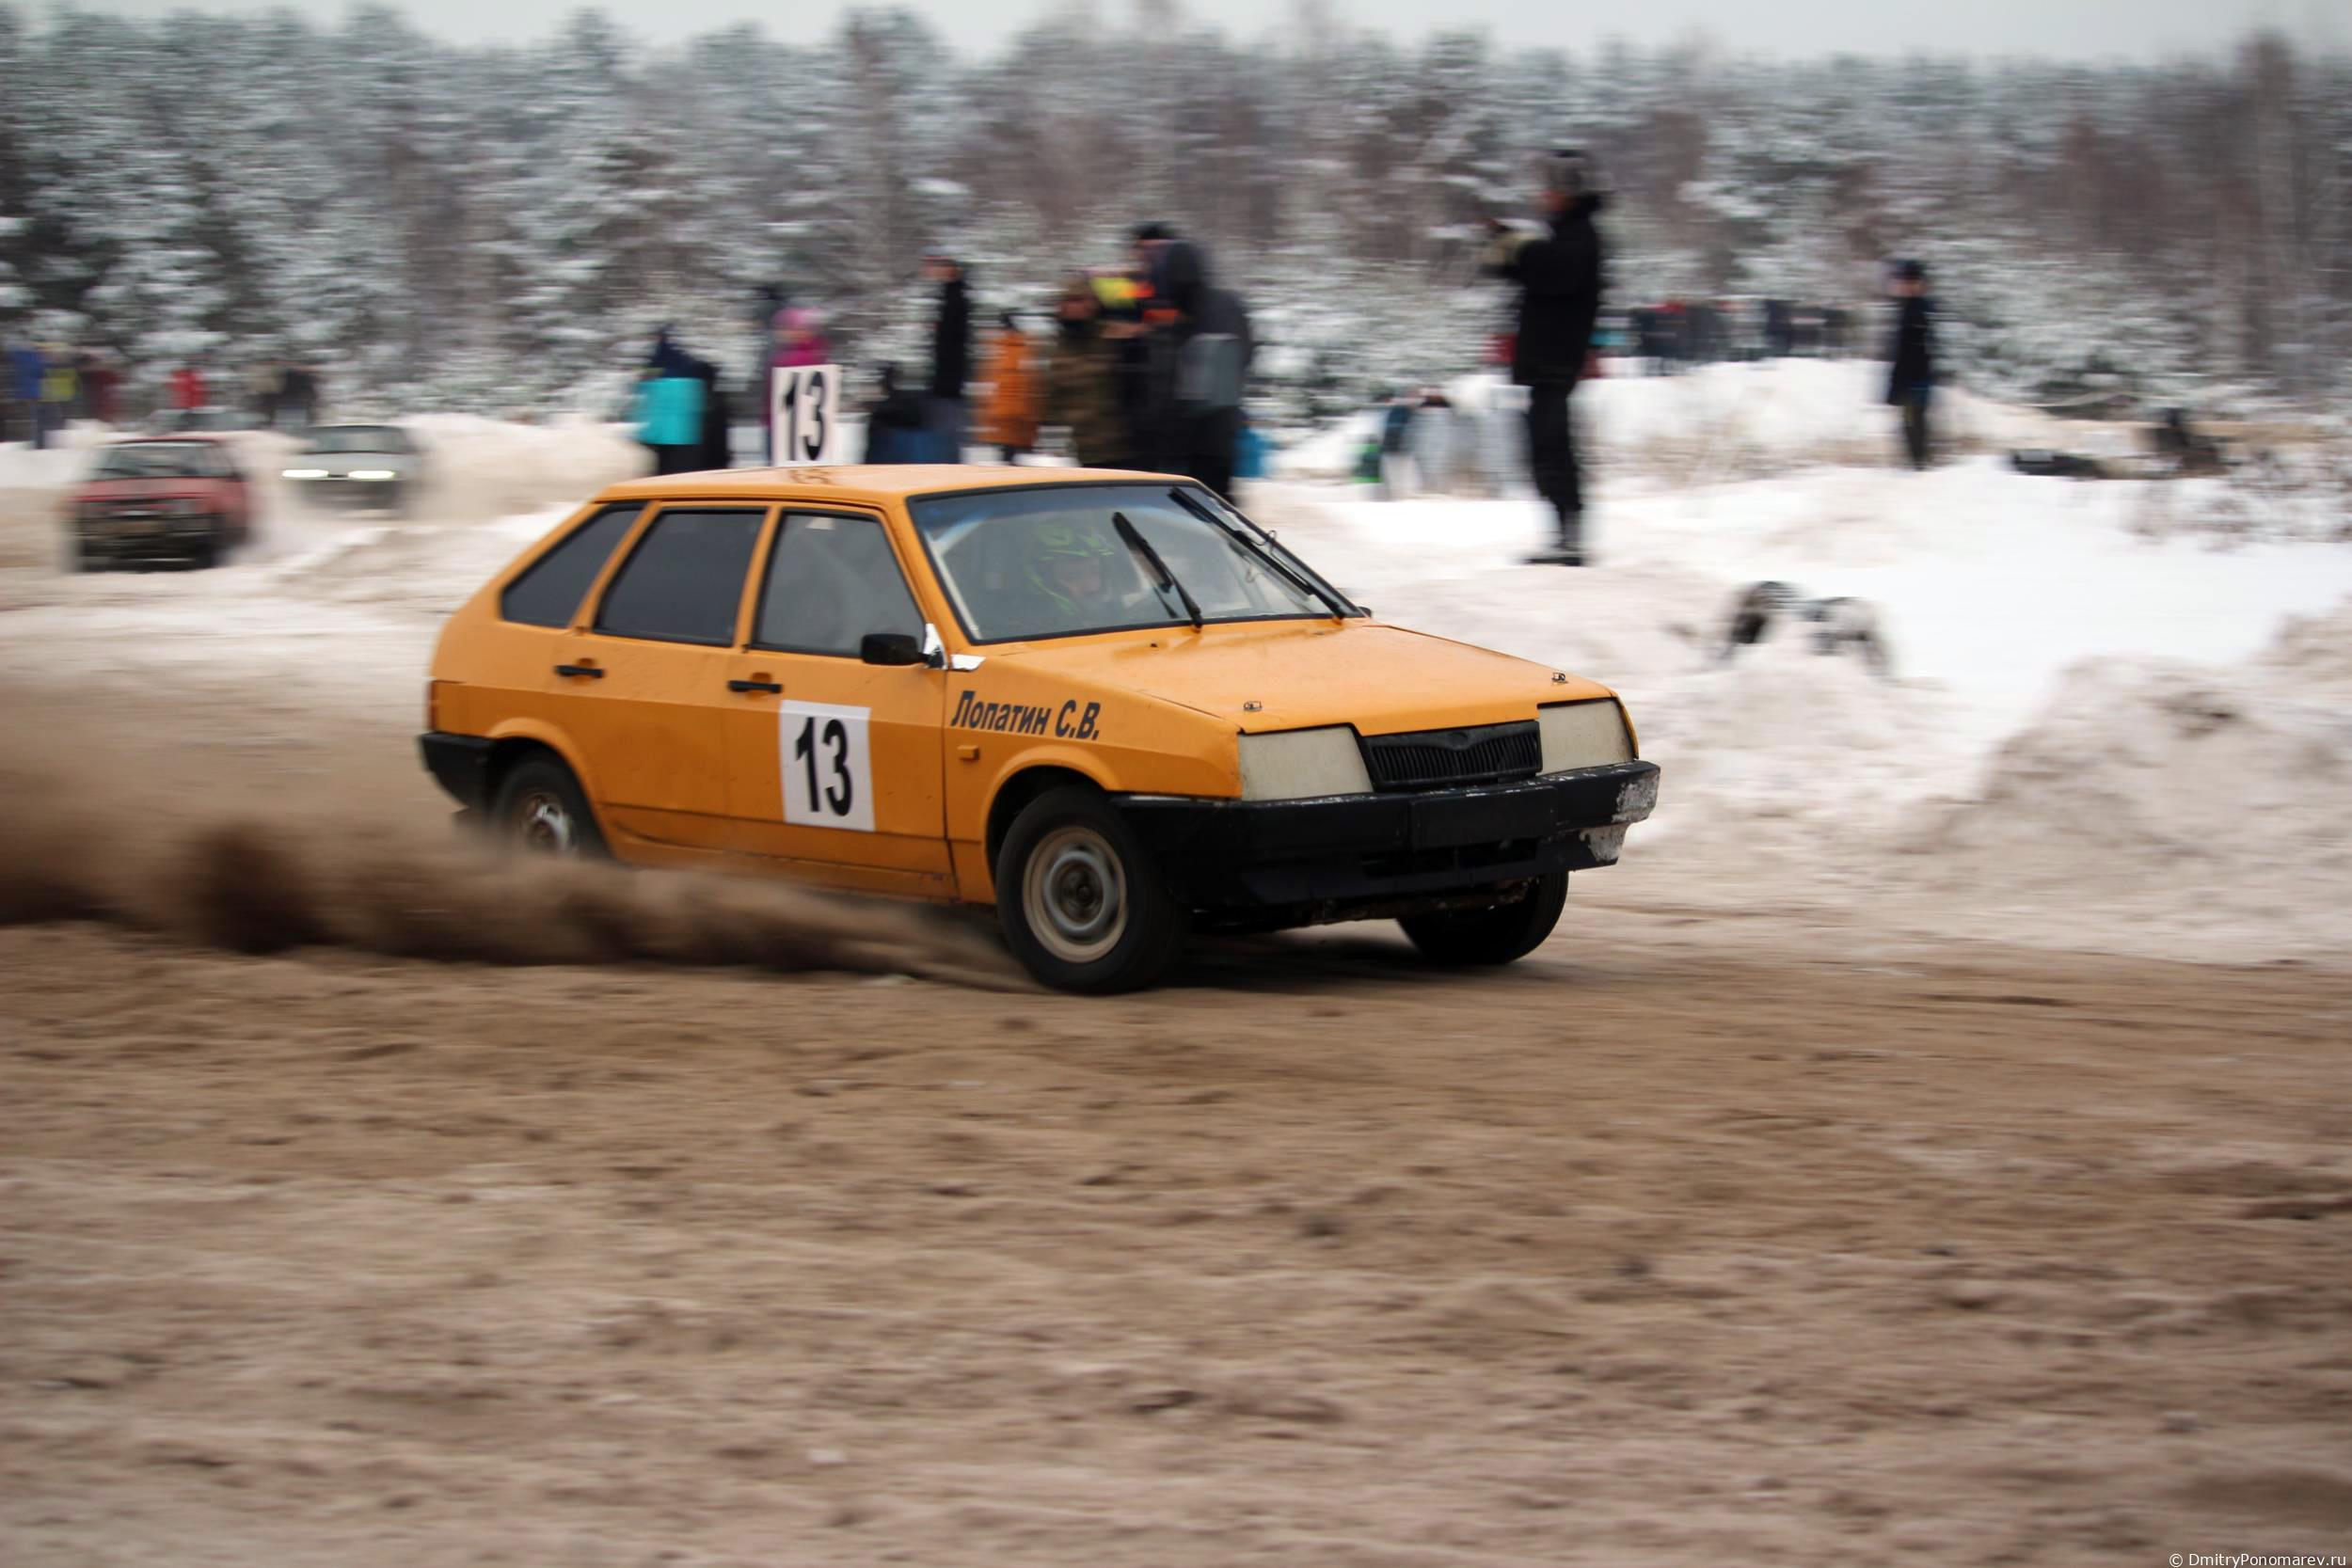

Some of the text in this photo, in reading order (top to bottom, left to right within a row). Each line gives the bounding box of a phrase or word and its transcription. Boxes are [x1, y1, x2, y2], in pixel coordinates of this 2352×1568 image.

[784, 371, 825, 462] 13
[950, 689, 1101, 741] Лопатин С.В.
[796, 716, 852, 817] 13
